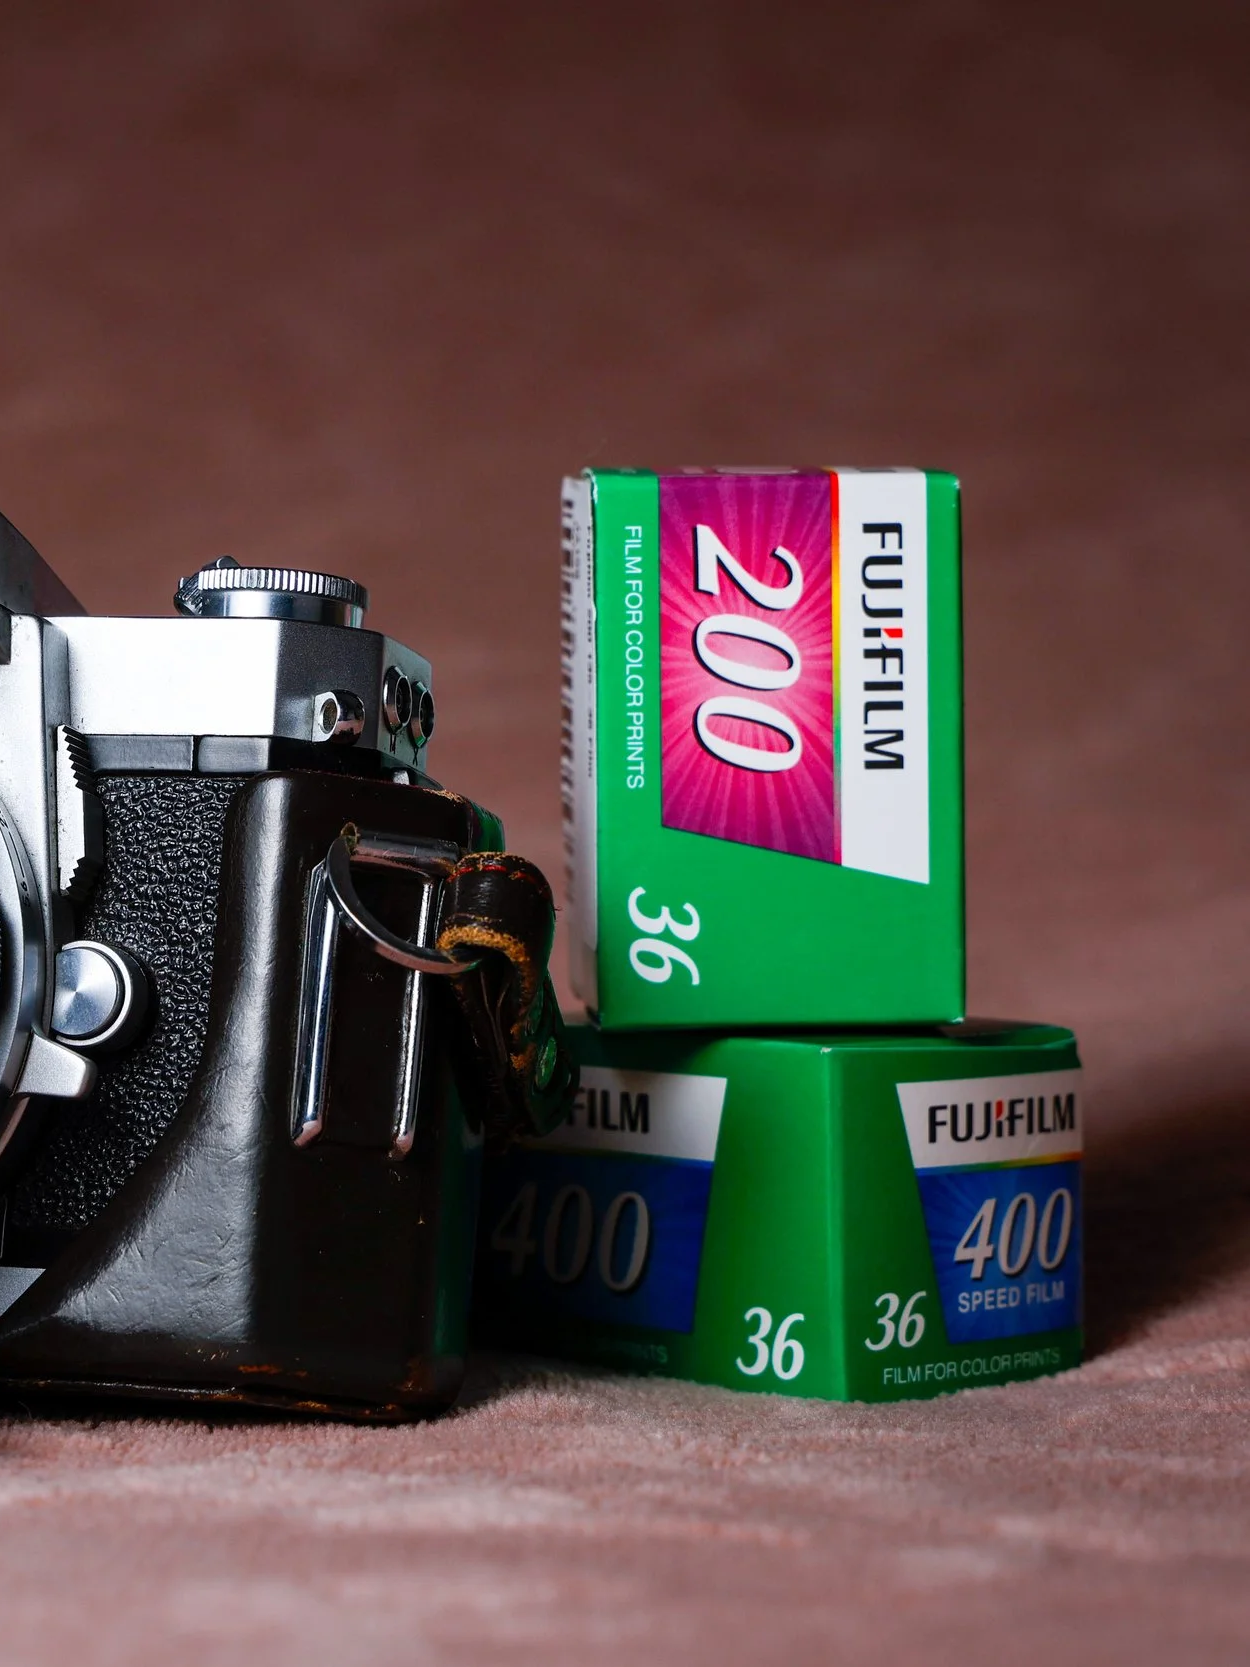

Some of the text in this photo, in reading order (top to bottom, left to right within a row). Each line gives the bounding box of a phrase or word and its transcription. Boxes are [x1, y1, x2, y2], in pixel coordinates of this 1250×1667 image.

[624, 525, 645, 789] FILM FOR COLOR PRINTS
[693, 524, 803, 773] 200
[862, 522, 904, 770] FUJIFILM
[627, 886, 700, 986] 36
[565, 1088, 649, 1133] FILM
[928, 1093, 1075, 1144] FUJIFILM
[491, 1181, 649, 1292] 400
[954, 1188, 1072, 1280] 400
[864, 1291, 927, 1351] 36
[957, 1280, 1065, 1314] SPEED FILM
[736, 1306, 804, 1380] 36
[883, 1347, 1060, 1385] FILM FOR COLOR PRINTS
